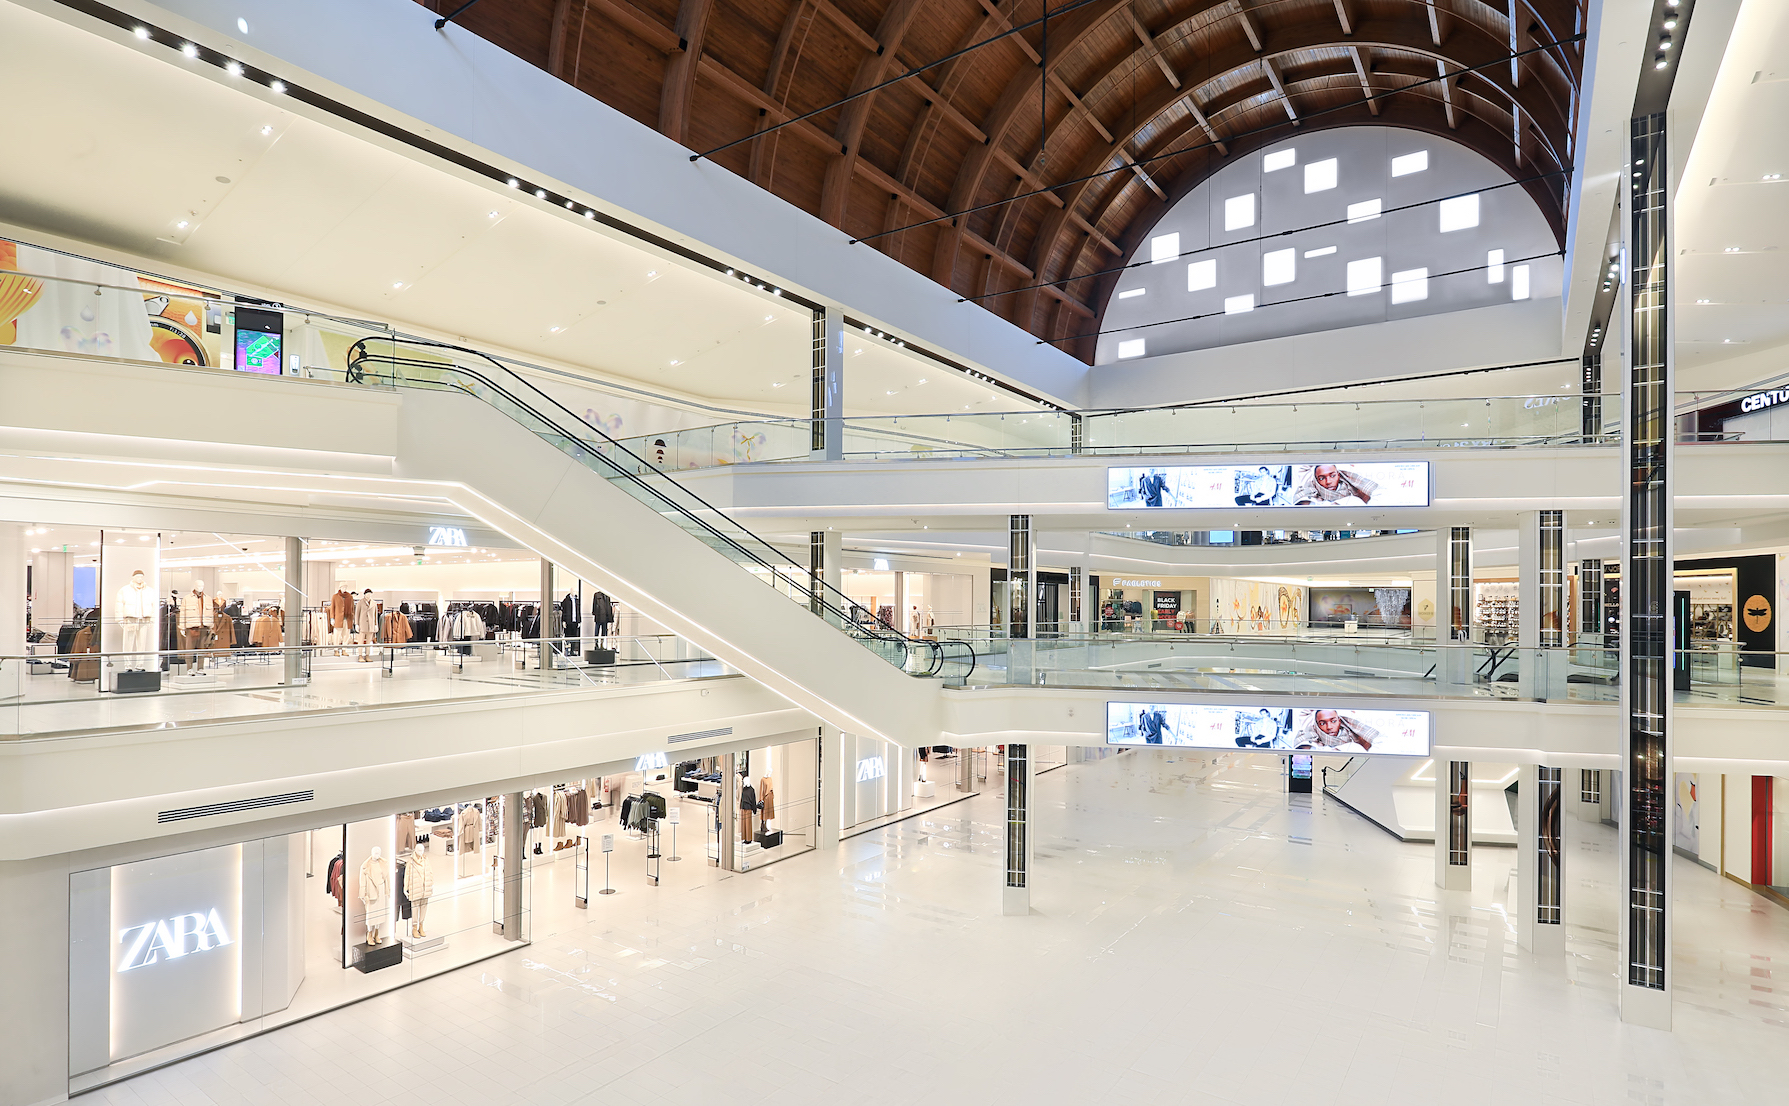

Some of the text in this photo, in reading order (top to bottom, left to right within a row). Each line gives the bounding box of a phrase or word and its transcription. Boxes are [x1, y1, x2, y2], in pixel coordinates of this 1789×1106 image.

[428, 526, 468, 547] ZARA
[634, 752, 668, 771] ZARA
[857, 756, 886, 783] ZARA
[117, 907, 235, 972] ZARA
